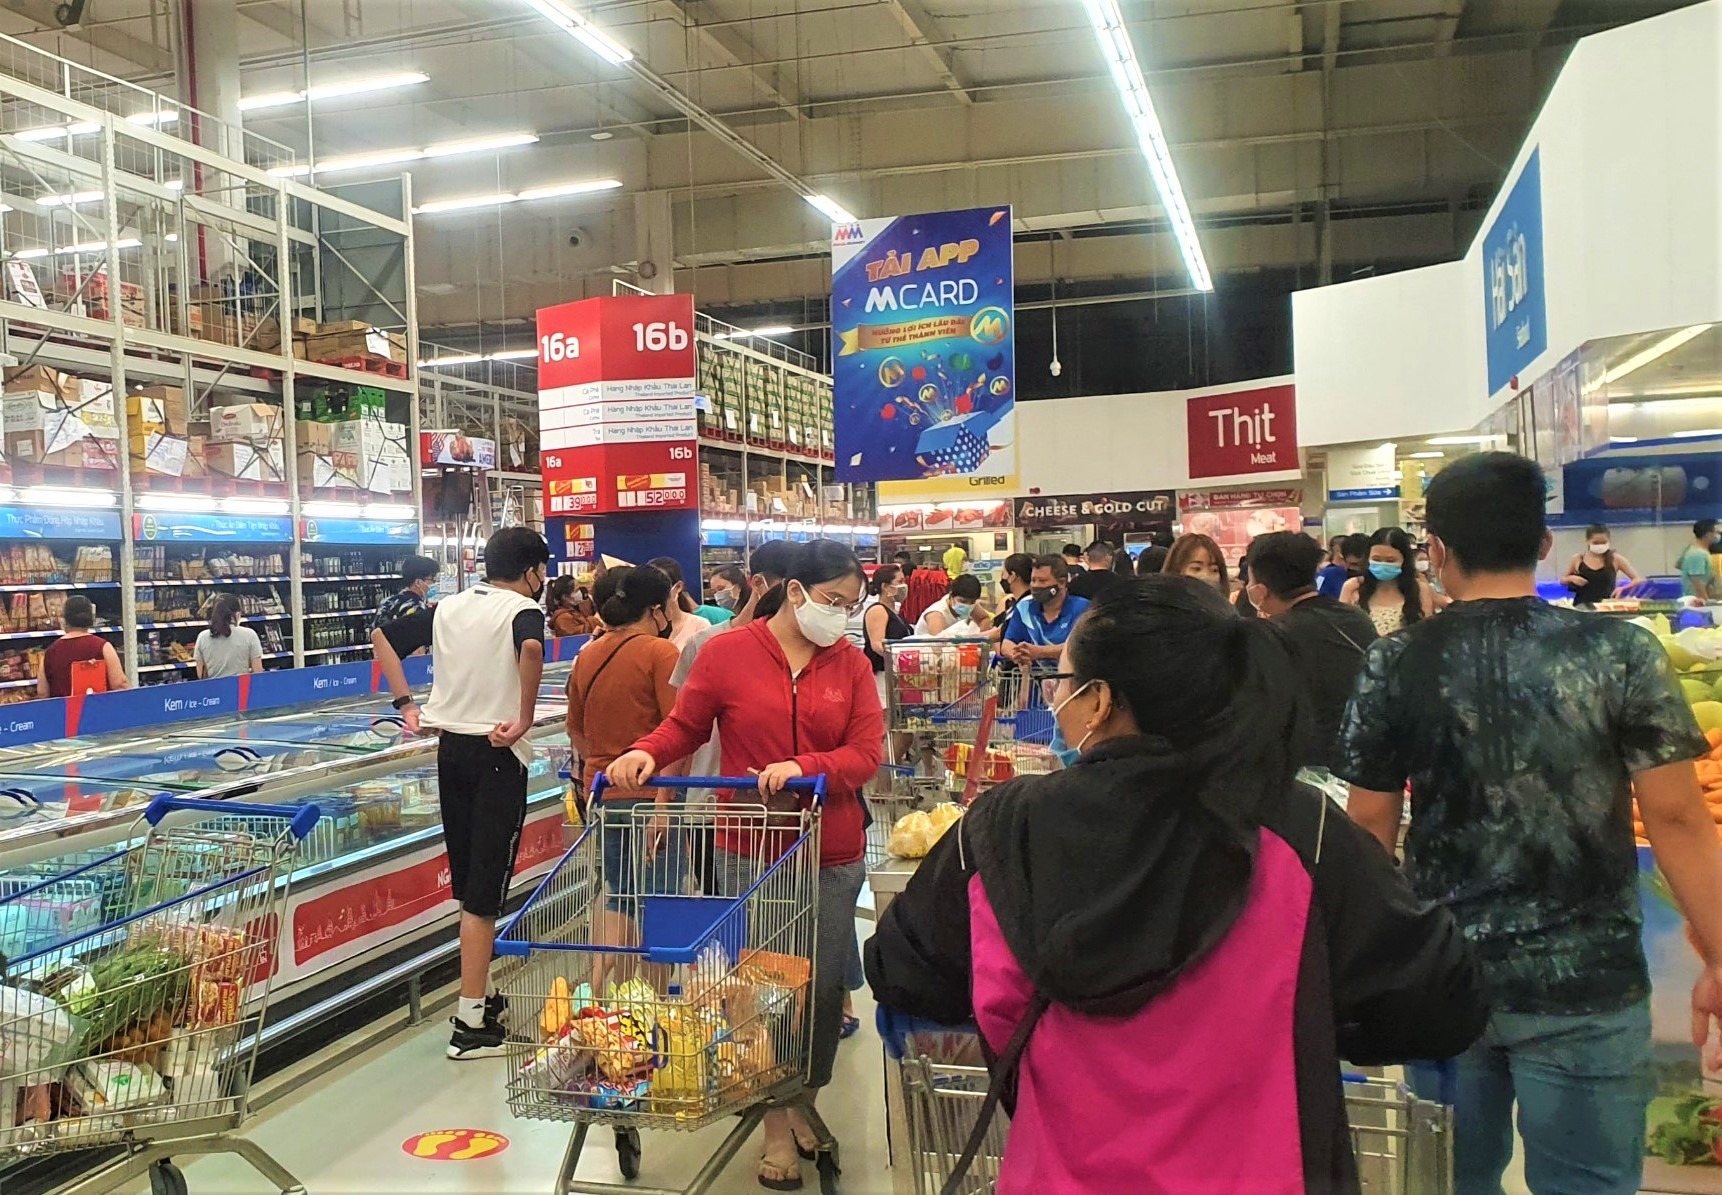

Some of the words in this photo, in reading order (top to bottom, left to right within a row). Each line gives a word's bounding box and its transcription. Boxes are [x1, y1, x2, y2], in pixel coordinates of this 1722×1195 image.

[866, 249, 912, 282] TẢI
[916, 239, 979, 272] APP
[632, 321, 688, 352] 16b
[541, 333, 580, 363] 16a
[1208, 402, 1276, 450] Thịt
[669, 447, 692, 459] 16b
[1251, 451, 1277, 464] Meat
[546, 456, 562, 468] 16a
[1025, 504, 1077, 517] CHEESE
[1081, 503, 1091, 514] &
[1136, 499, 1164, 512] CUT
[313, 676, 328, 689] Kem
[164, 698, 183, 712] Kem
[203, 697, 220, 707] Cream
[10, 721, 34, 732] Cream
